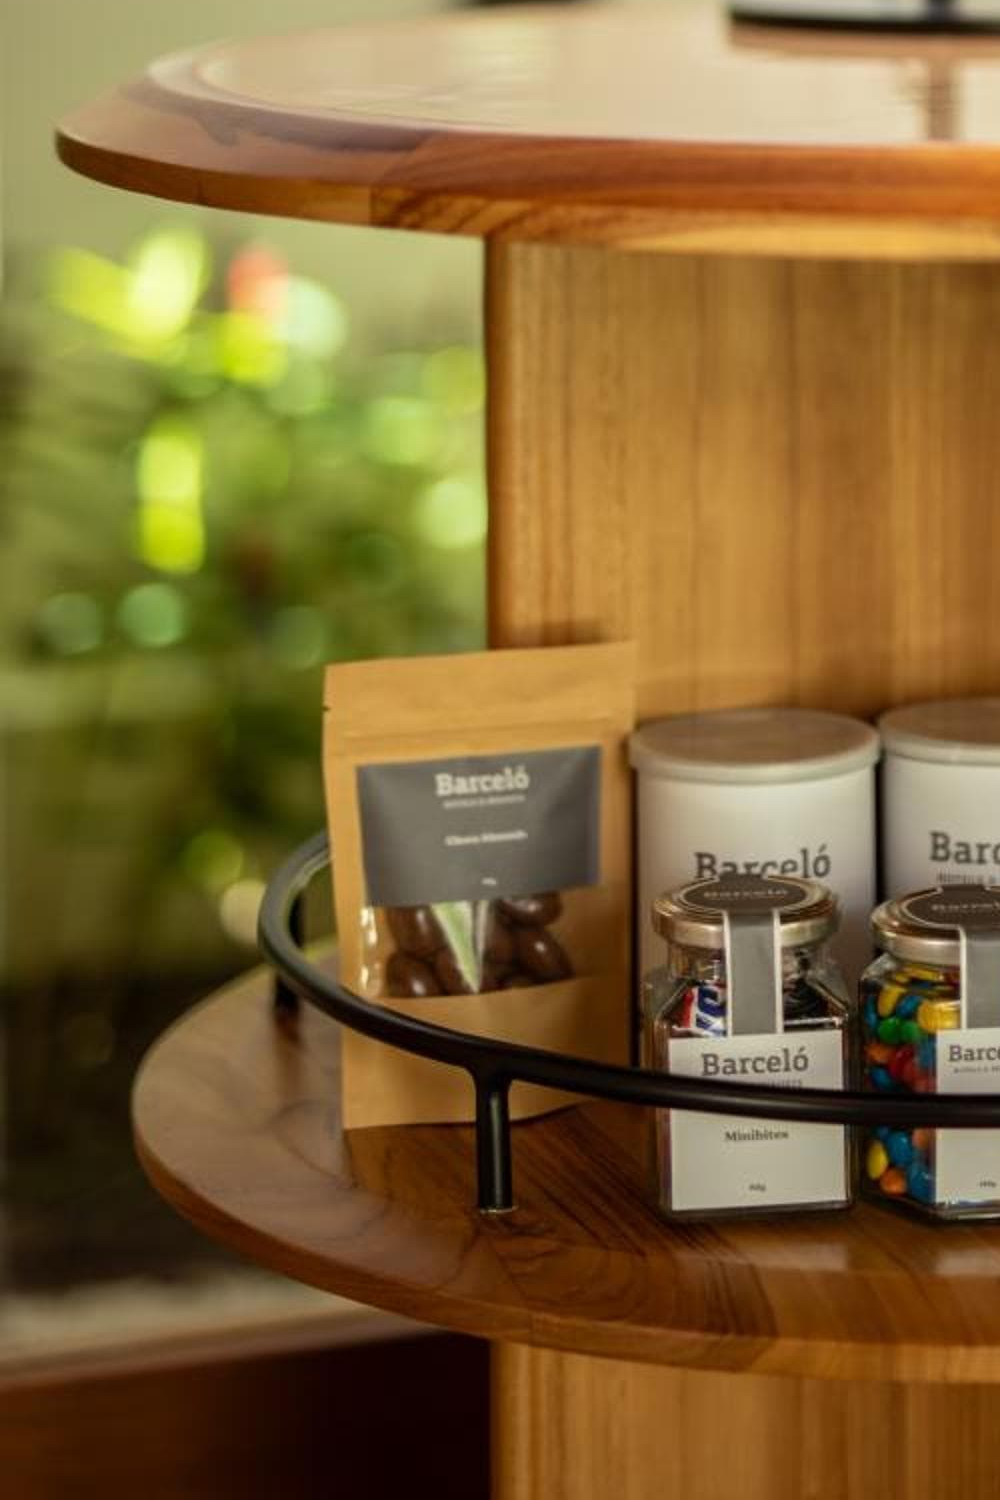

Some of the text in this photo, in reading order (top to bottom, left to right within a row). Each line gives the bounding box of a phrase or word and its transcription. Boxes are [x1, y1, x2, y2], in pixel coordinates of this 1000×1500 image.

[435, 765, 529, 797] Barceló
[701, 1046, 809, 1076] Barceló
[725, 1129, 790, 1142] Minibites
